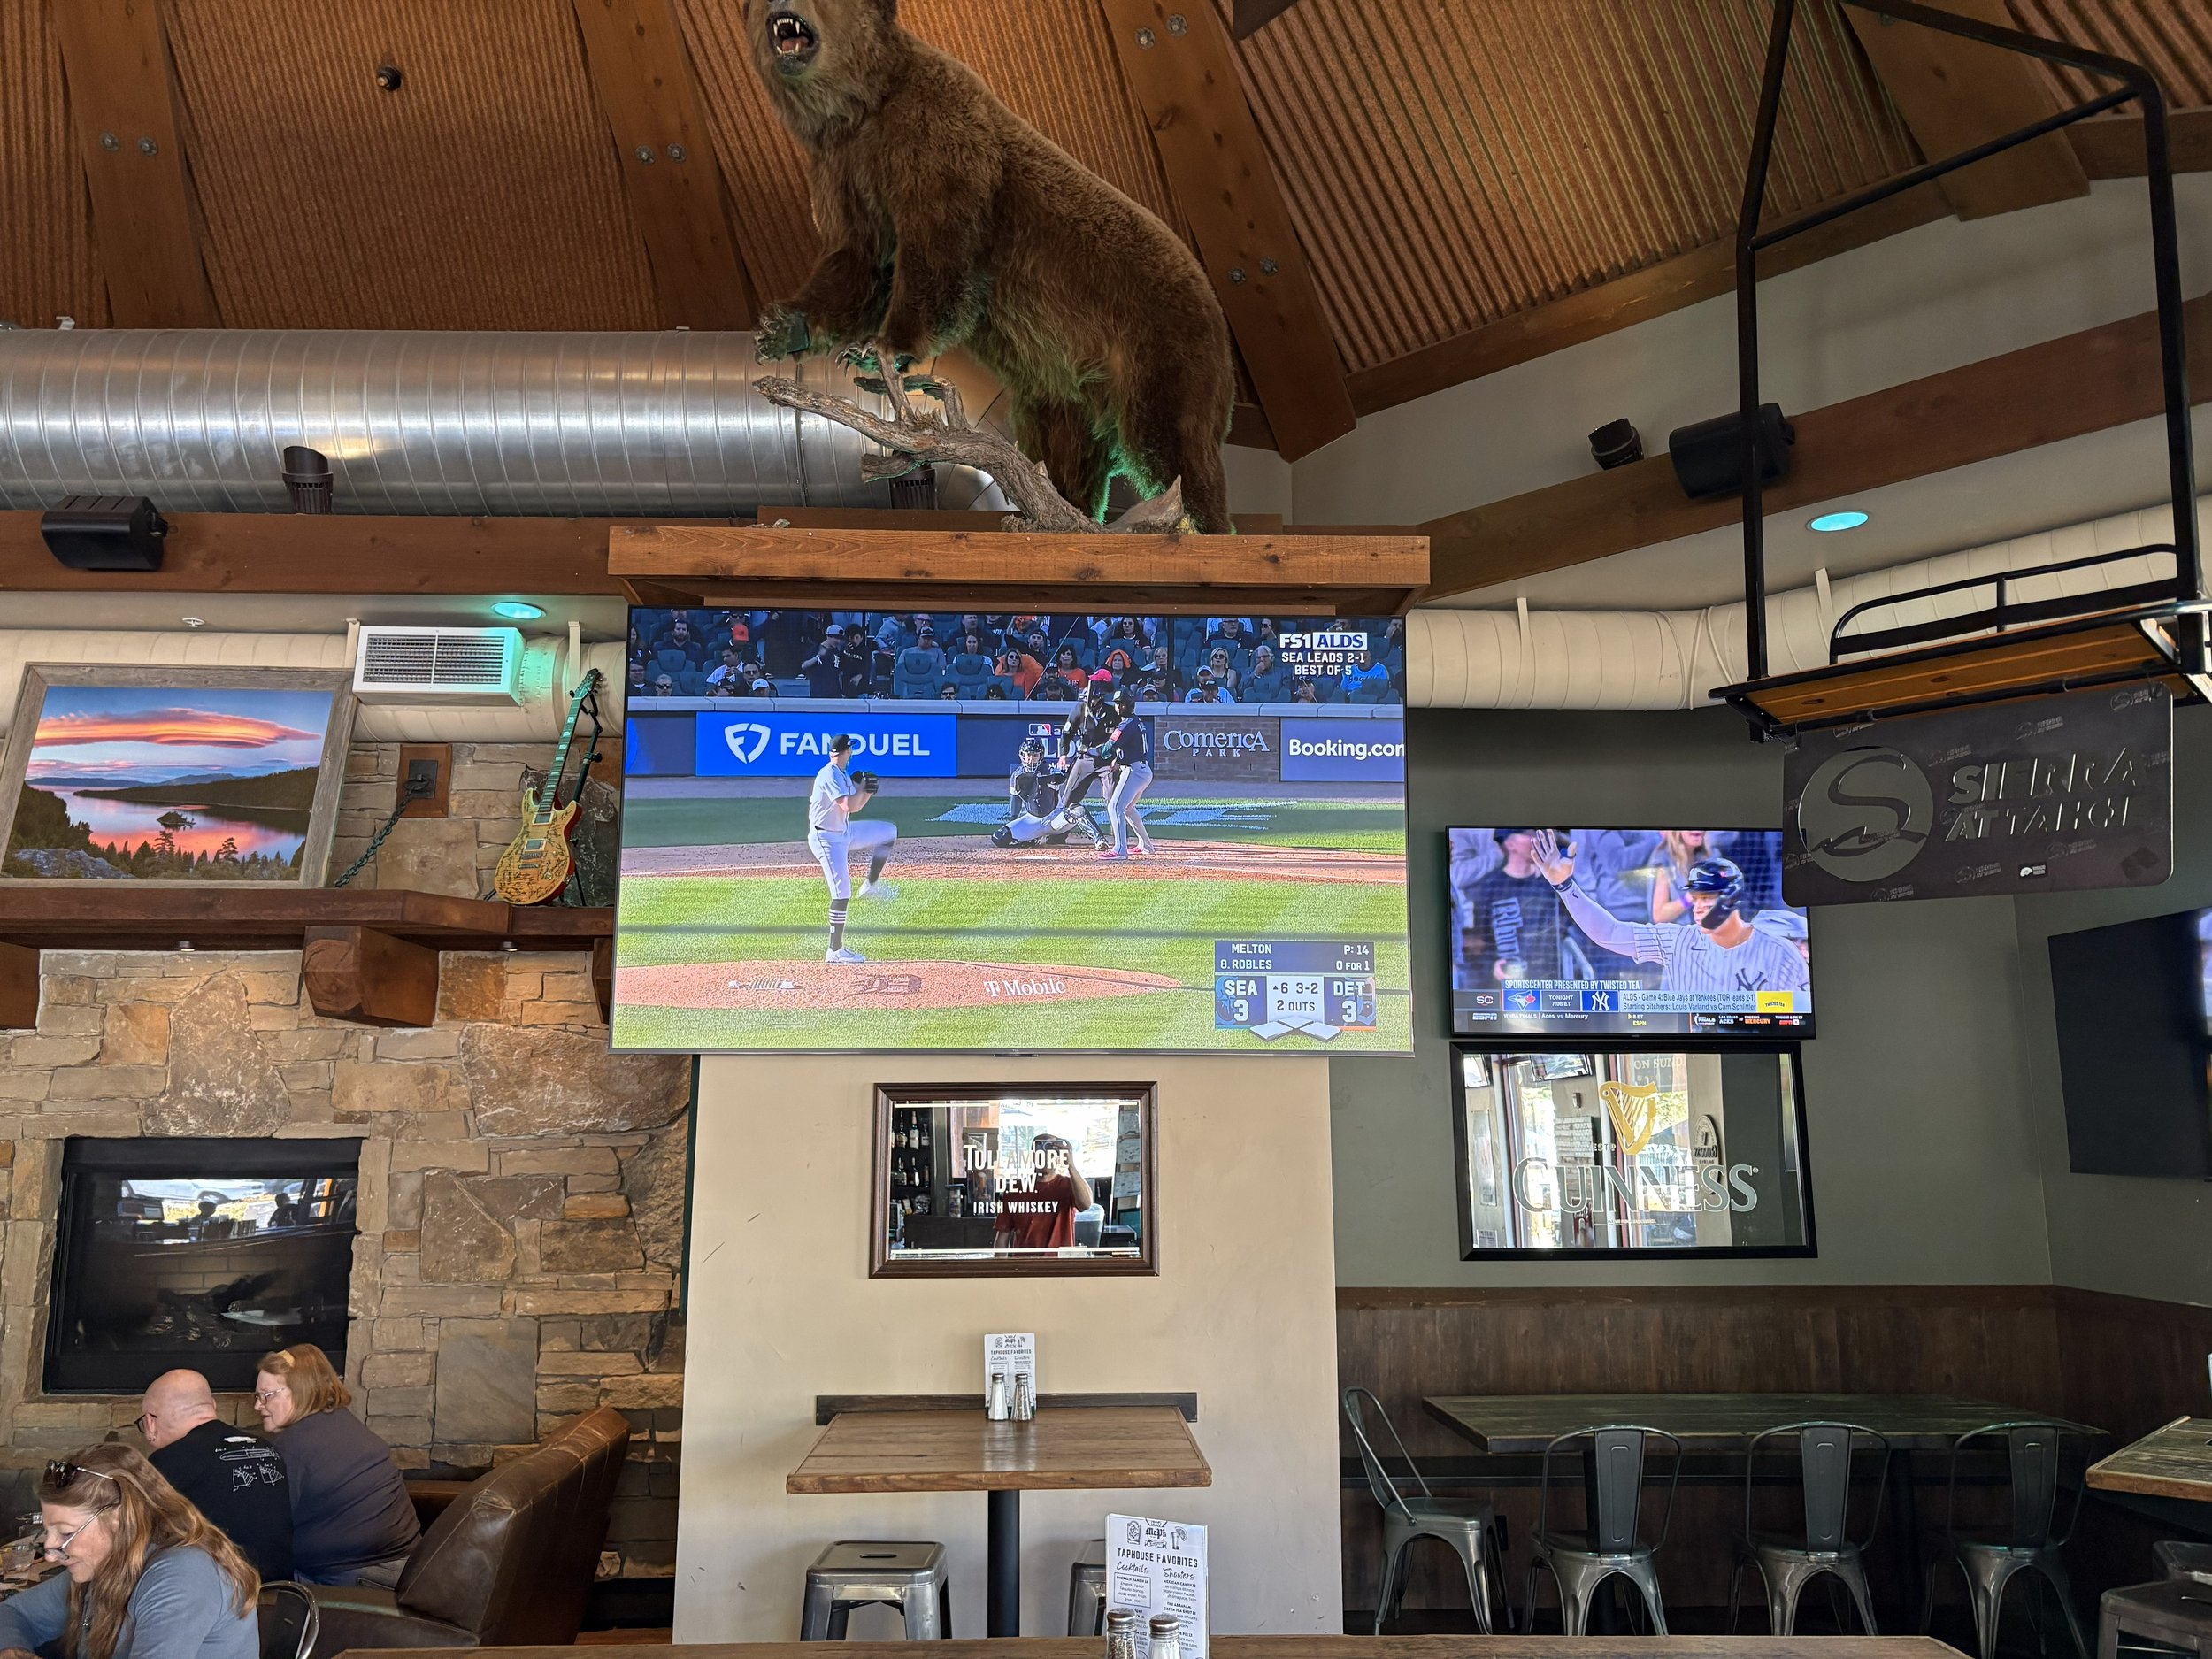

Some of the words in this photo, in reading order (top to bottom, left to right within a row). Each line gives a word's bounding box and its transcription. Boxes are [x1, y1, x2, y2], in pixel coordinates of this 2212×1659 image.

[1279, 634, 1311, 649] FS1
[1317, 634, 1363, 648] ALDS
[1281, 653, 1303, 663] SEA
[1307, 653, 1343, 663] LEADS
[1347, 653, 1365, 663] 2-1
[1294, 665, 1323, 675] BEST
[1327, 665, 1340, 675] OF
[1345, 665, 1352, 675] 5
[1192, 748, 1241, 757] PARK
[1232, 944, 1271, 954] MELTON
[1344, 945, 1354, 955] P:
[1356, 945, 1369, 955] 14
[1232, 960, 1272, 970] ROBLES
[1364, 961, 1370, 971] 1
[1002, 978, 1067, 996] Mobile
[1225, 980, 1257, 995] SEA
[1280, 983, 1288, 994] 6
[1296, 983, 1318, 994] 3-2
[1333, 981, 1364, 996] DET
[1505, 980, 1553, 989] SPORTSCENTER
[1555, 980, 1589, 989] PRESENTED
[1591, 980, 1599, 989] BY
[1600, 980, 1627, 990] TWISTED
[1629, 980, 1640, 990] TEA
[1623, 993, 1638, 1002] ALDS
[1642, 993, 1657, 1002] Game
[1664, 993, 1676, 1002] Blue
[1677, 993, 1688, 1003] Jays
[1695, 993, 1716, 1002] Yankees
[1717, 993, 1731, 1002] (TOR
[1732, 993, 1745, 1002] leads
[1234, 1000, 1249, 1021] 3
[1277, 1000, 1285, 1011] 2
[1288, 1002, 1316, 1011] OUTS
[1624, 1002, 1645, 1011] Starting
[1646, 1002, 1671, 1011] pitchers:
[1342, 1001, 1357, 1023] 3
[973, 1202, 1003, 1214] IRISH
[1008, 1201, 1059, 1213] WHISKEY
[1117, 1548, 1155, 1563] TAPHOUSE
[1156, 1553, 1198, 1568] FAVORITES
[1116, 1561, 1149, 1574] Cocktails
[1163, 1567, 1195, 1581] Shooters
